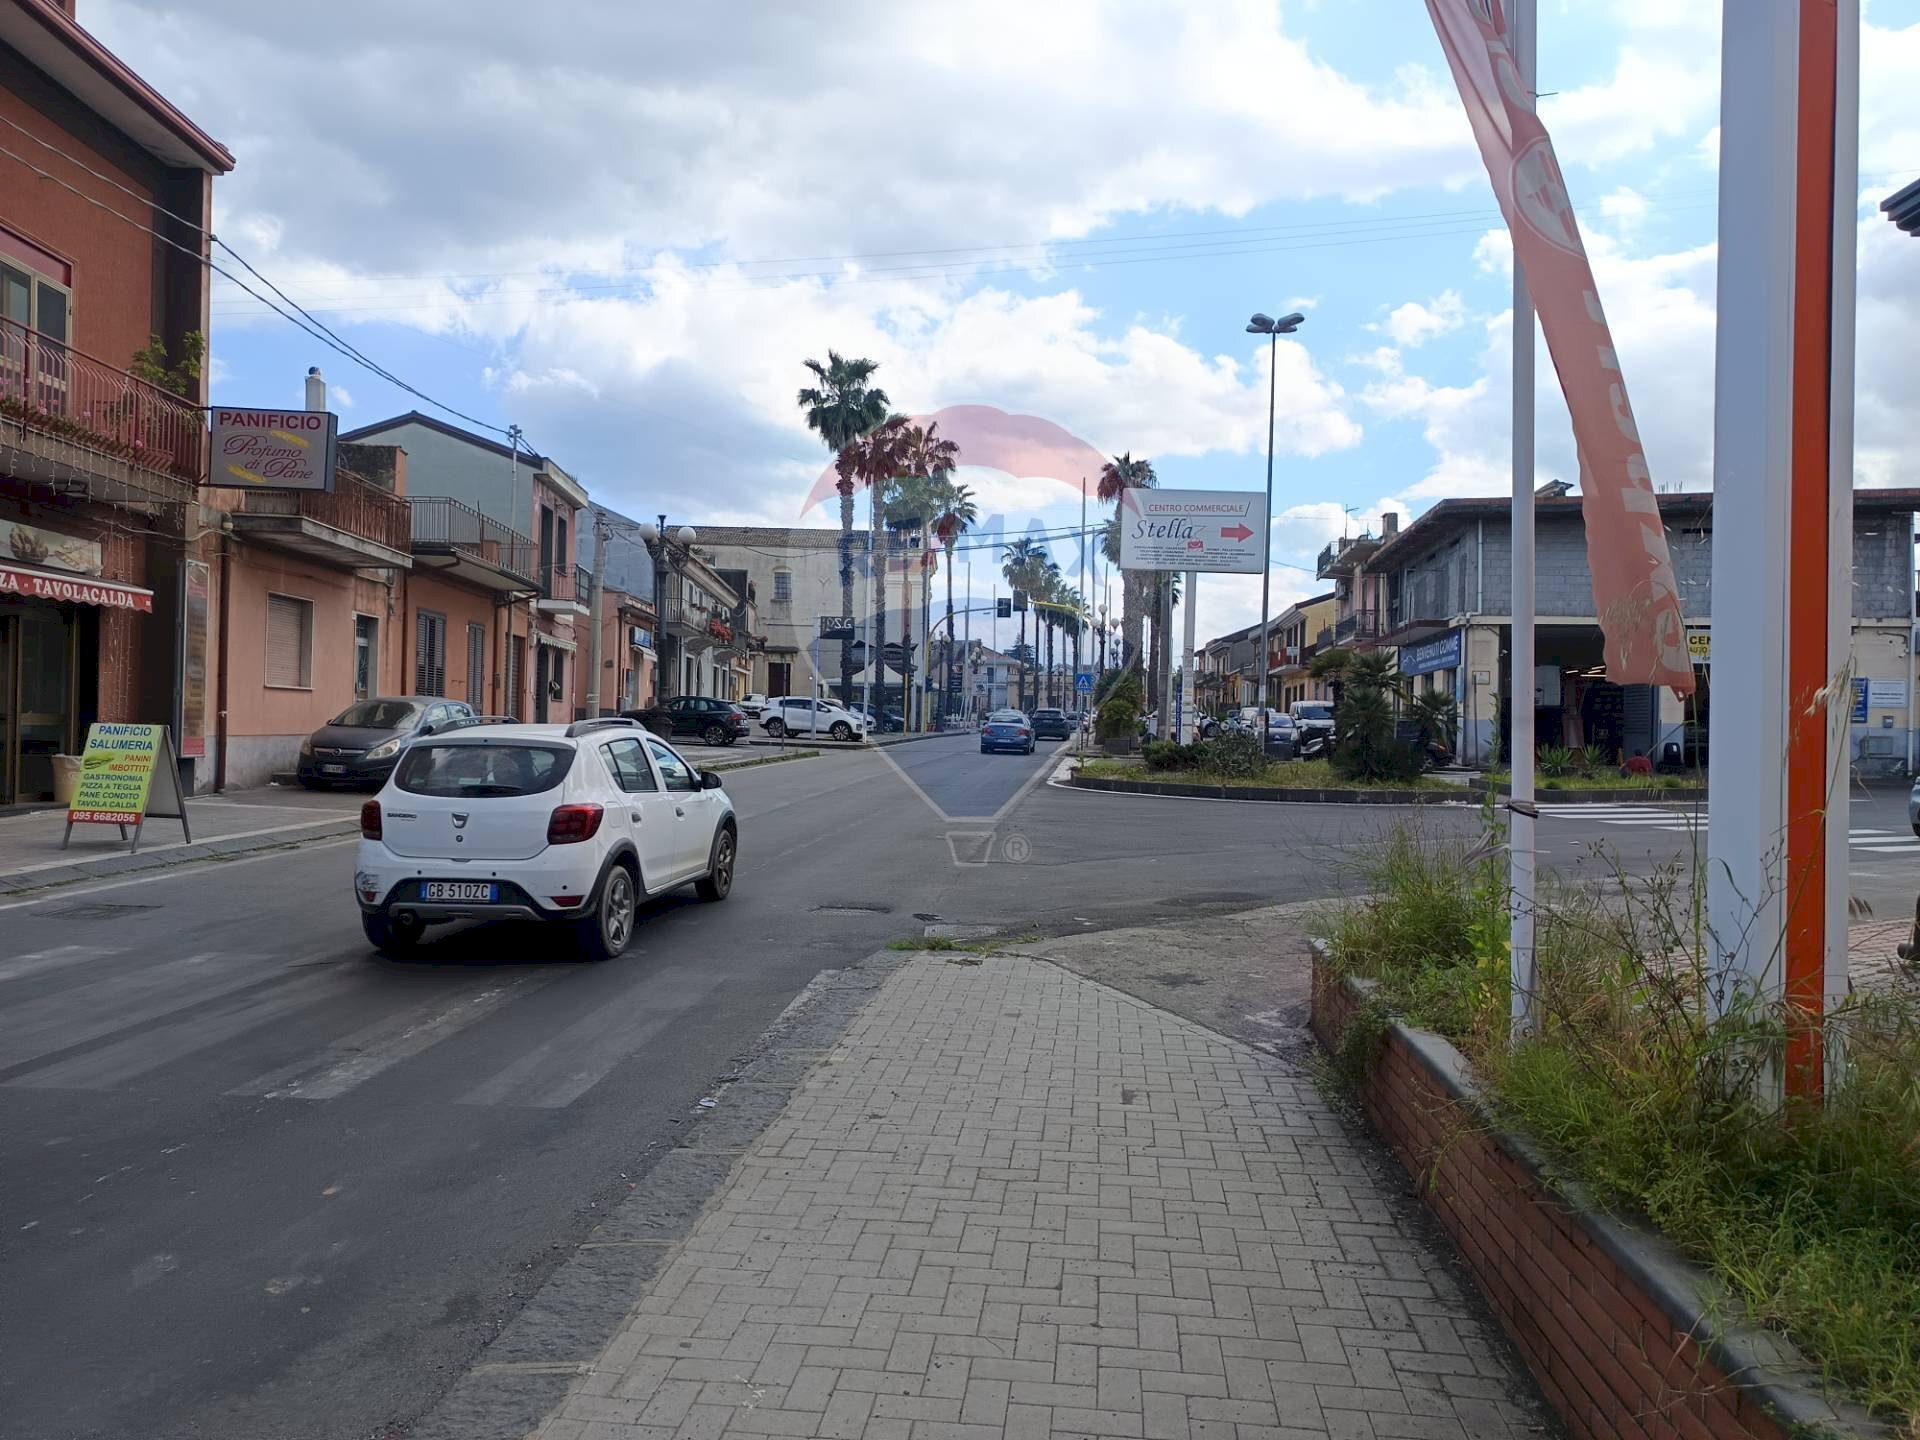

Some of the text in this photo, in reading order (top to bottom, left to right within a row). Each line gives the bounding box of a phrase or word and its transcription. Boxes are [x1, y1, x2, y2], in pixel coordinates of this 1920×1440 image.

[220, 412, 321, 430] PANIFICIO
[223, 434, 302, 458] Profumo
[244, 458, 313, 479] di Pane
[1149, 504, 1244, 513] CENTRO COMMERCIALE
[1131, 518, 1193, 540] Stella
[33, 578, 134, 607] TAVOLACALDA
[99, 725, 152, 736] PANIFICIO
[90, 739, 153, 750] SALUMERIA
[124, 754, 151, 762] PANINI
[83, 773, 143, 782] GASTRONOMIA
[113, 783, 141, 791] TEGLIA
[73, 811, 136, 822] 095 6682056
[429, 884, 488, 898] GB 510ZC
